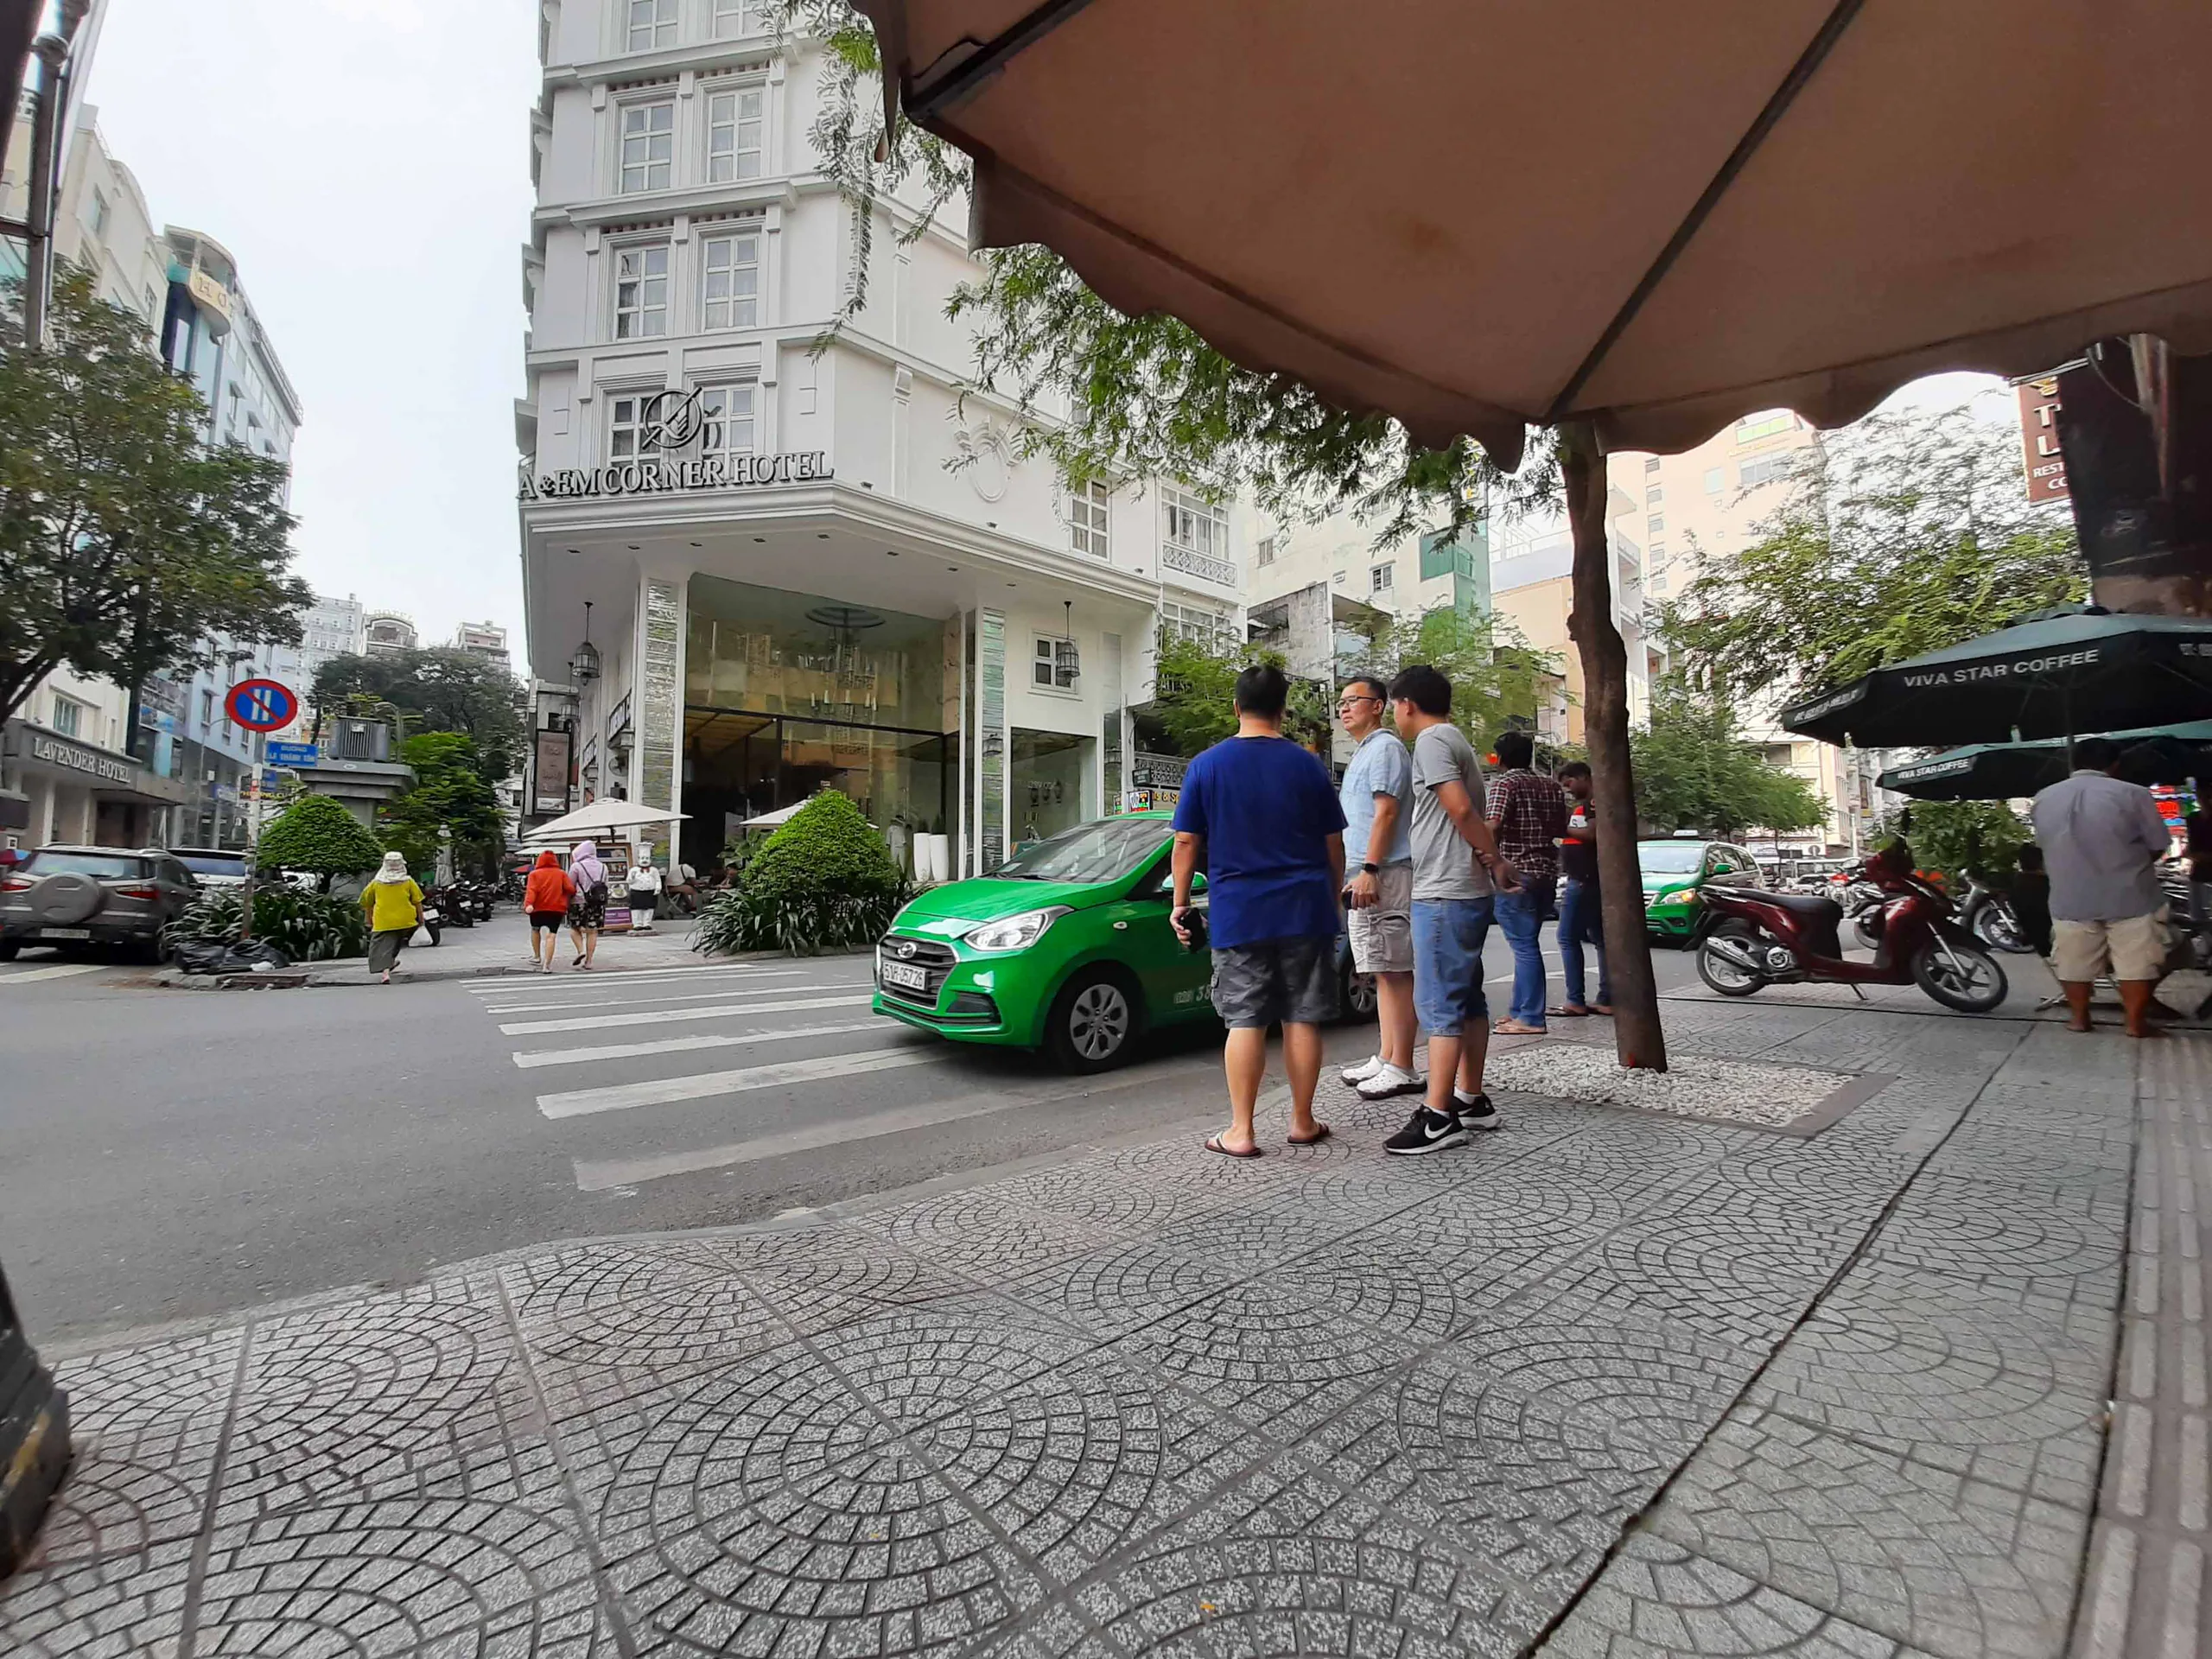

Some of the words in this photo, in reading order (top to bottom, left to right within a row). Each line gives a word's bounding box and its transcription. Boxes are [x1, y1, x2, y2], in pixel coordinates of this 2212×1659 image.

[602, 458, 727, 494] CORNER
[732, 451, 835, 485] HOTEL
[1904, 672, 1948, 687] VIVA
[1954, 664, 2008, 683] STAR
[2013, 649, 2100, 674] COFFEE
[34, 737, 96, 773] LAVENDER
[98, 759, 131, 784] HOTEL
[1897, 770, 1916, 779] VIVA
[1916, 765, 1937, 777] STAR
[1937, 759, 1969, 772] COFFEE
